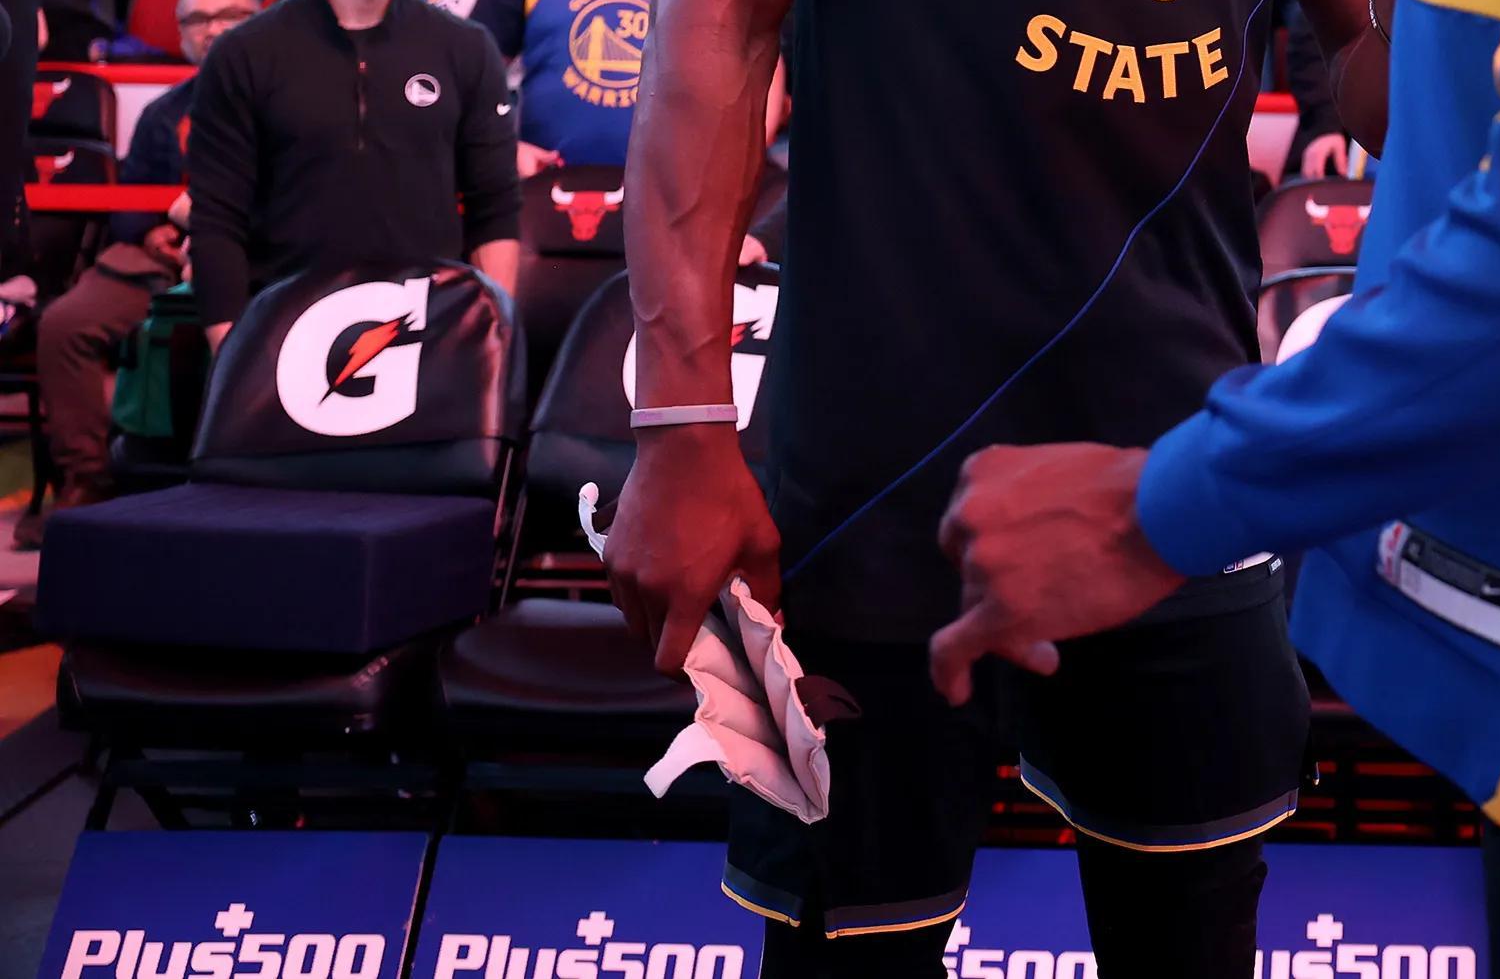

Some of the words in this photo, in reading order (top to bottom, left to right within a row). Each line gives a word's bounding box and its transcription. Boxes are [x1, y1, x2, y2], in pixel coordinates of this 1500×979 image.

[615, 9, 649, 40] 30
[1015, 14, 1229, 103] STATE
[276, 277, 431, 437] G
[60, 930, 386, 979] Plus500
[433, 933, 744, 979] Plus500
